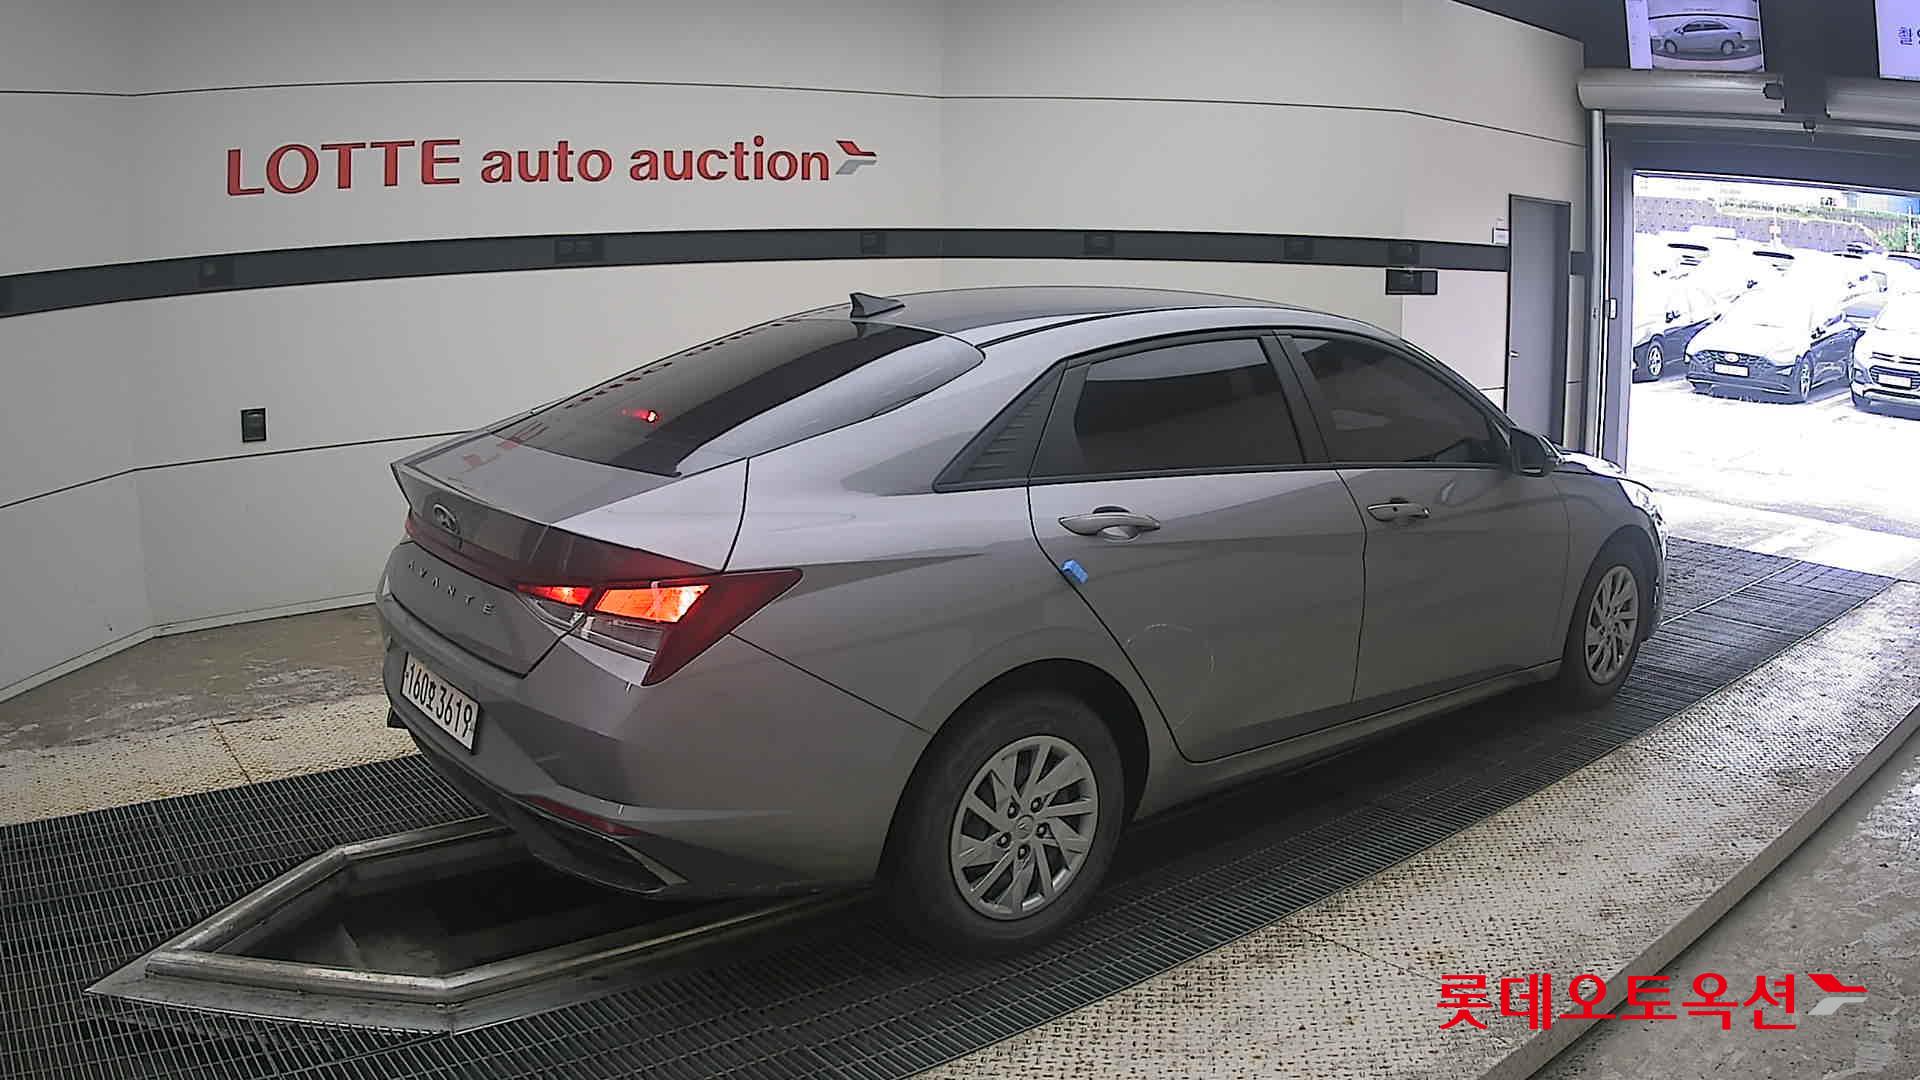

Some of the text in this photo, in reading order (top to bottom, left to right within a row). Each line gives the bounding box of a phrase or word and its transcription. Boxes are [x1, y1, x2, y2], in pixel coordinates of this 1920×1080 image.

[226, 136, 829, 197] LOTTE auto auction
[408, 560, 495, 615] AVANTE
